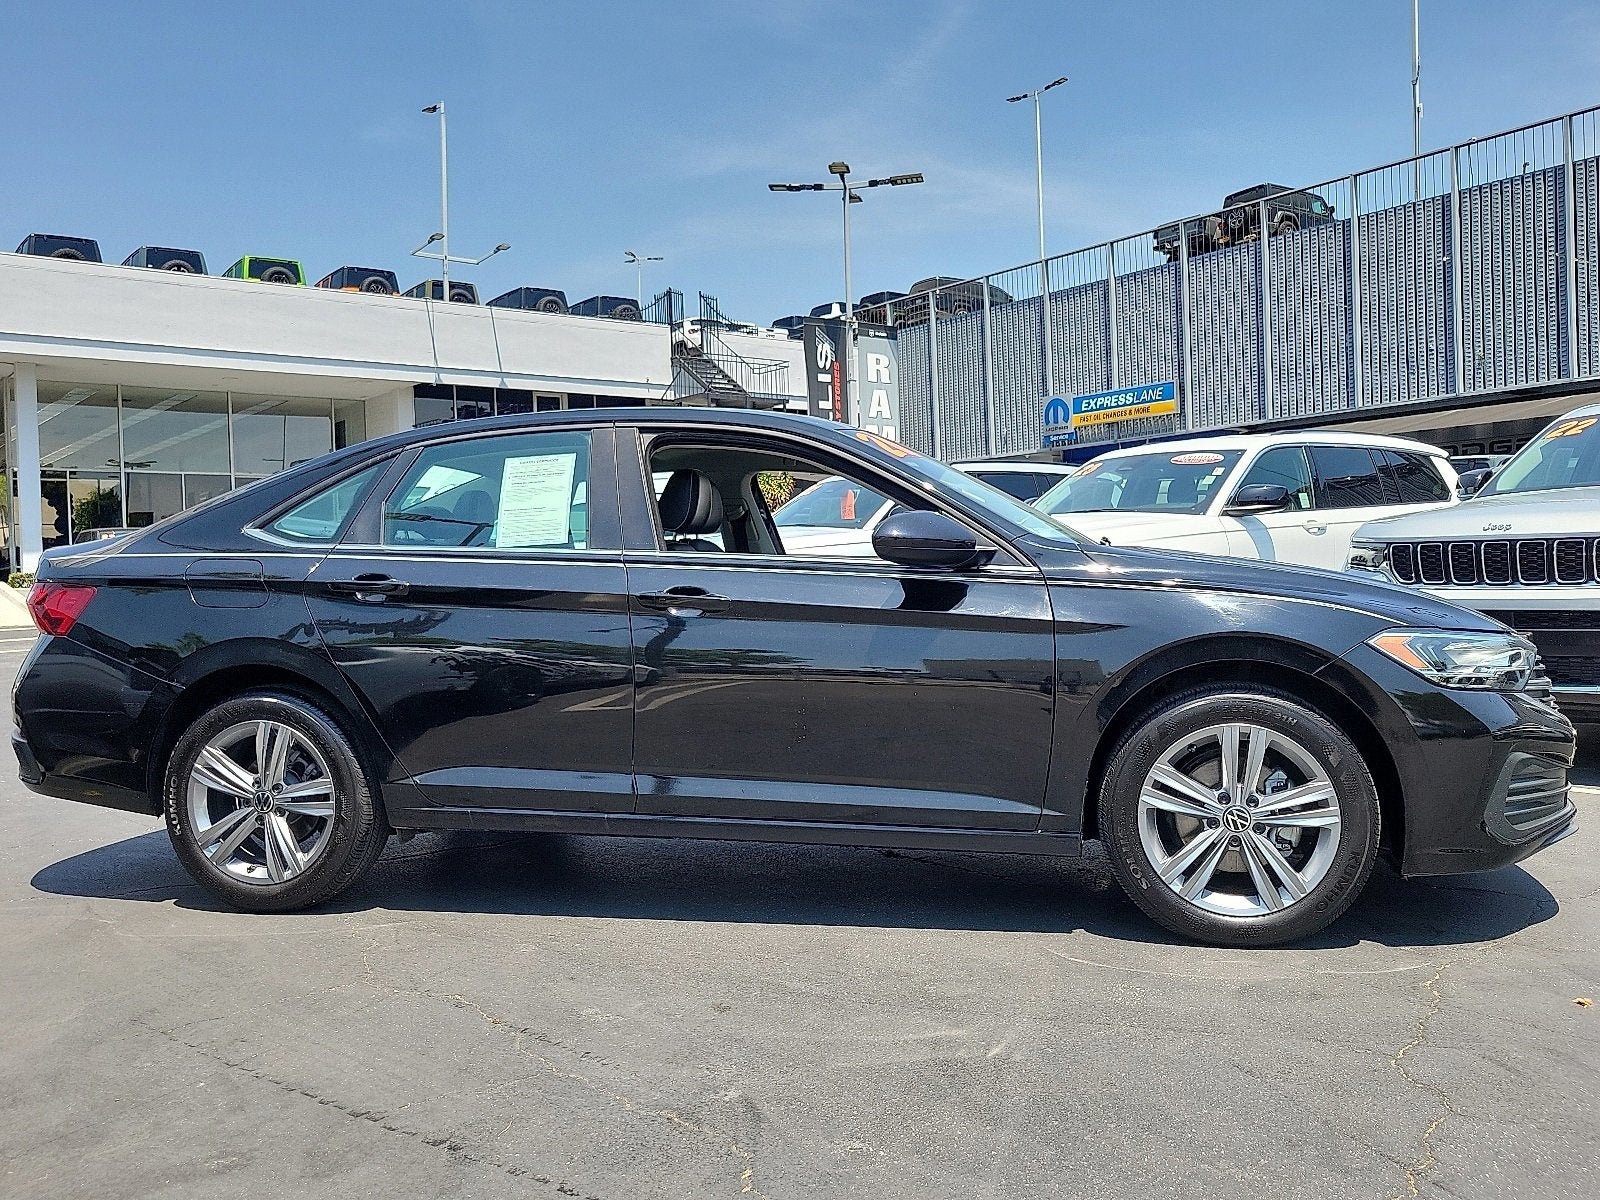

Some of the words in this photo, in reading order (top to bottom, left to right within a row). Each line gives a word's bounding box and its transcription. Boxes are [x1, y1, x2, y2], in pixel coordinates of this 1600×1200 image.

[1079, 415, 1092, 424] FAST
[1102, 409, 1127, 420] CHANGES
[1133, 405, 1151, 416] MORE
[1049, 434, 1069, 442] Service
[1482, 522, 1512, 532] Jeep
[169, 775, 182, 836] KUMHO
